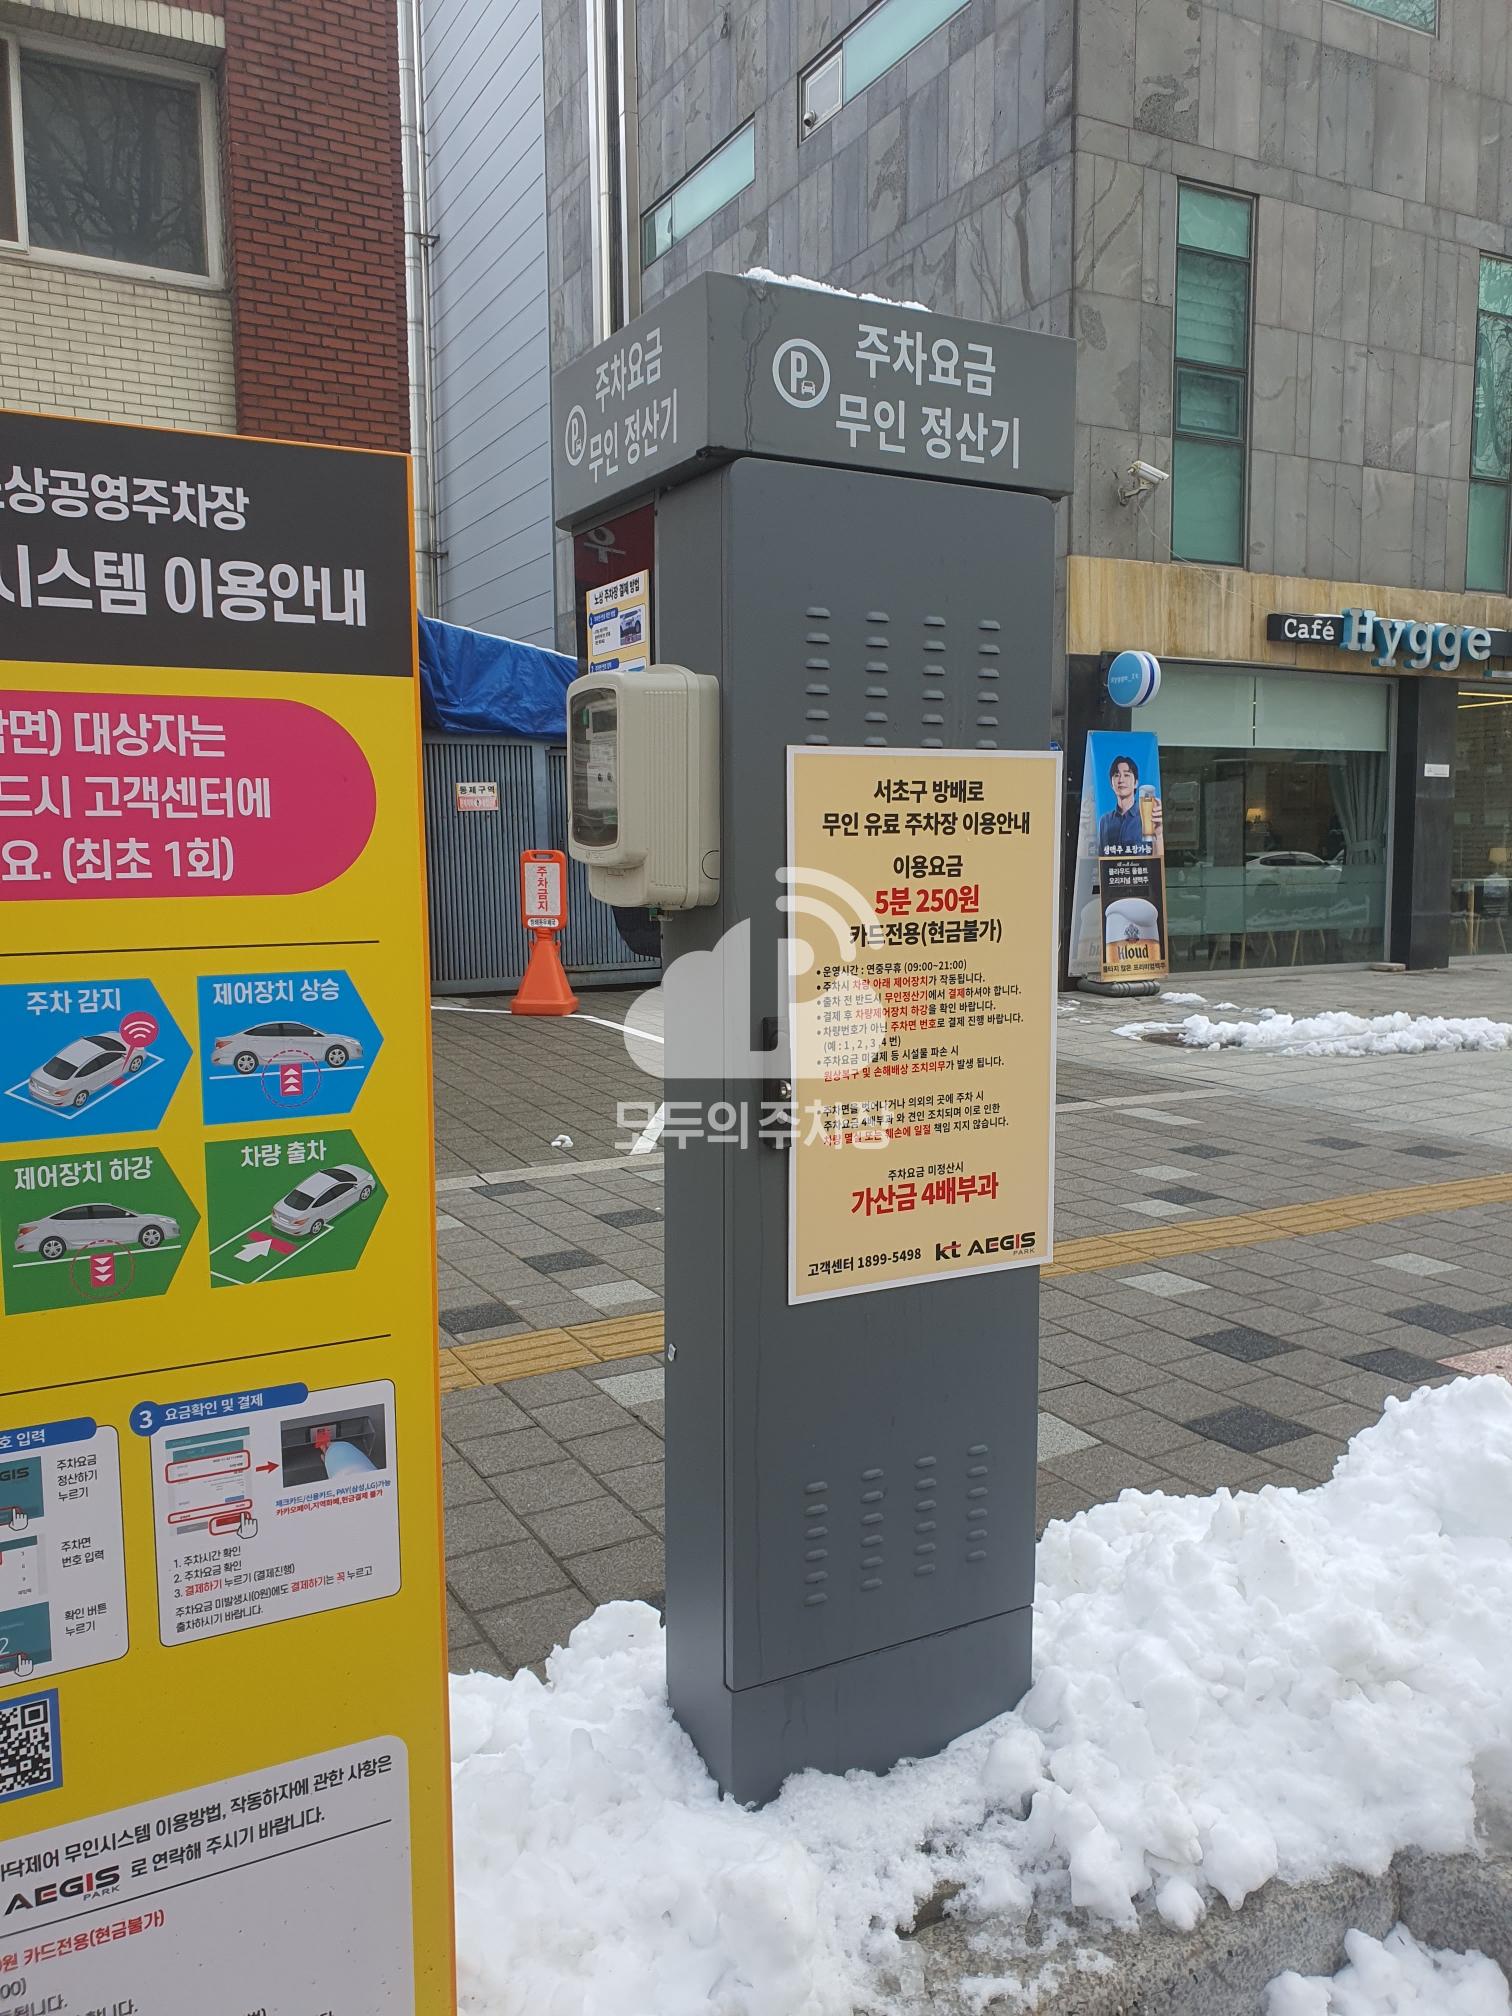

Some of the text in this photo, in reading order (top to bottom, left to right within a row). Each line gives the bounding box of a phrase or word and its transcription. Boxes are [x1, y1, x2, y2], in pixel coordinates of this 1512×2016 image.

[594, 326, 664, 414] 주차요금
[855, 322, 997, 398] 주차요금
[588, 387, 679, 484] 무인 정산기
[835, 392, 1021, 470] 무인 정산기
[0, 465, 250, 531] 상공영주차장
[164, 556, 367, 626] 이용안내
[1283, 607, 1492, 671] Café Hygge
[74, 712, 226, 758] 대상자는
[85, 776, 271, 819] 고객센터에
[873, 779, 985, 804] 서초구 방배로
[822, 811, 1030, 837] 무인 유료 주차장 이용안내
[2, 836, 235, 884] 요. (최초 1회)
[893, 855, 963, 879] 이용요금
[536, 866, 549, 912] 주차금지
[874, 884, 980, 916] 5분 250원
[849, 918, 1002, 948] 카드전용(현금불가)
[823, 959, 967, 978] 운영시간 연중무휴 (09:00~21:00)
[823, 972, 986, 991] 주차시 차량 아래 제어장치가 작동됩니다.
[26, 987, 121, 1016] 주차 감지
[212, 978, 340, 1006] 제어장치 상승
[823, 984, 1022, 1008] 출차 전 반드시 무인정산기에서 결제하셔야 합니다.
[823, 1000, 996, 1023] 결제 후 차량제어장치 하강을 확인 바랍니다.
[823, 1012, 1024, 1037] 차량번호가 아닌 주차면 번호로 결제 진행 바랍니다.
[823, 1045, 959, 1067] 주차요금 미결제 등 시설물 파손 시
[824, 1056, 1005, 1083] 원상복구 및 손해배상 조치의무가 발생 됩니다.
[823, 1090, 984, 1117] 주차면을 벗어나거나 의외의 곳에 주차 시
[824, 1103, 1000, 1132] 주차요금 4배부과 견인 조치되며 이로 인한
[914, 1116, 1009, 1136] 일절 책임 지지 않습니다.
[241, 1140, 327, 1169] 차량 출차
[14, 1156, 153, 1191] 제어장치 하강
[888, 1161, 964, 1180] 주차요금 미정산시
[851, 1172, 999, 1217] 가산금 4배부과
[935, 1231, 1036, 1262] kt AEGIS
[807, 1248, 922, 1277] 고객센터 1899-5498
[138, 1393, 263, 1429] 3 요금확인 및 결제
[16, 1429, 45, 1447] 입력
[57, 1454, 97, 1471] 주차요금
[57, 1469, 98, 1487] 정산하기
[58, 1487, 89, 1502] 누르기
[60, 1536, 92, 1552] 주차면
[183, 1546, 241, 1567] 주차시간 확인
[62, 1550, 104, 1568] 번호 입력
[184, 1560, 242, 1582] 주차요금 확인
[175, 1565, 373, 1618] 주차요금 미발생시(0원)에도 결제하기는 꼭 누르고
[185, 1563, 295, 1597] 결제하기 누르기 (결제진행)
[64, 1602, 107, 1621] 확인 버튼
[176, 1605, 264, 1633] 출차하시기 바랍니다.
[65, 1620, 96, 1637] 누르기
[65, 1822, 151, 1863] 무인시스템
[156, 1803, 226, 1837] 이용방법,
[230, 1777, 309, 1814] 작동하자에
[313, 1768, 345, 1792] 관한
[347, 1755, 392, 1781] 사항은
[5, 1806, 325, 1916] AEGIS 로 연락해 주시기 바랍니다.
[83, 1884, 121, 1901] PARK
[23, 1909, 165, 1967] 카드전용(현금불가)
